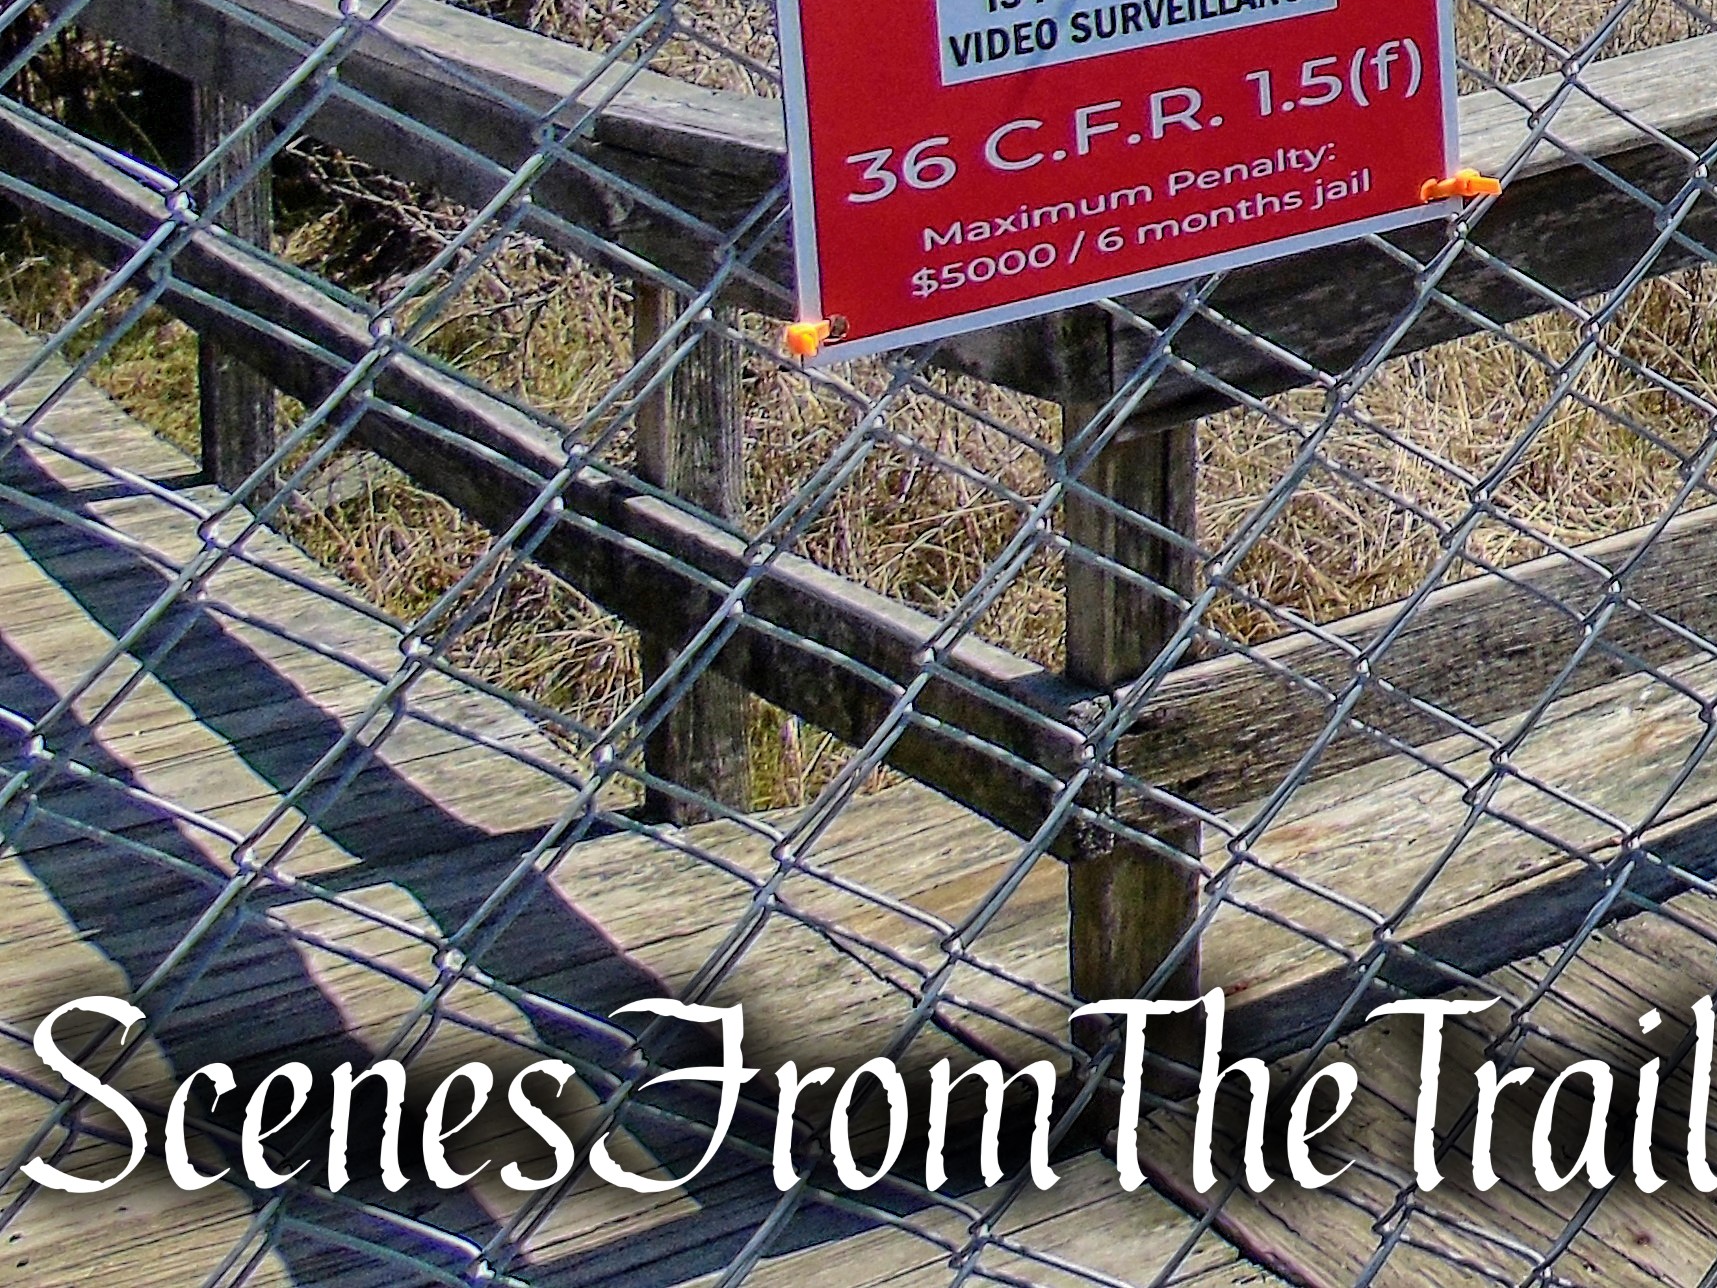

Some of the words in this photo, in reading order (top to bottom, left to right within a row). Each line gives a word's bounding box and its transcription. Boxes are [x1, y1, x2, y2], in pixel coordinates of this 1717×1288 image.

[948, 18, 1059, 69] VIDEO
[846, 134, 959, 205] 36
[984, 85, 1225, 174] C.F.R.
[1245, 36, 1425, 117] 1.5(f)
[910, 240, 1056, 299] $5000
[1064, 229, 1086, 268] /
[1096, 225, 1125, 255] 6
[1136, 187, 1305, 246] months
[1311, 168, 1373, 215] jail
[921, 179, 1153, 252] Maximum
[1168, 140, 1339, 199] Penalty:
